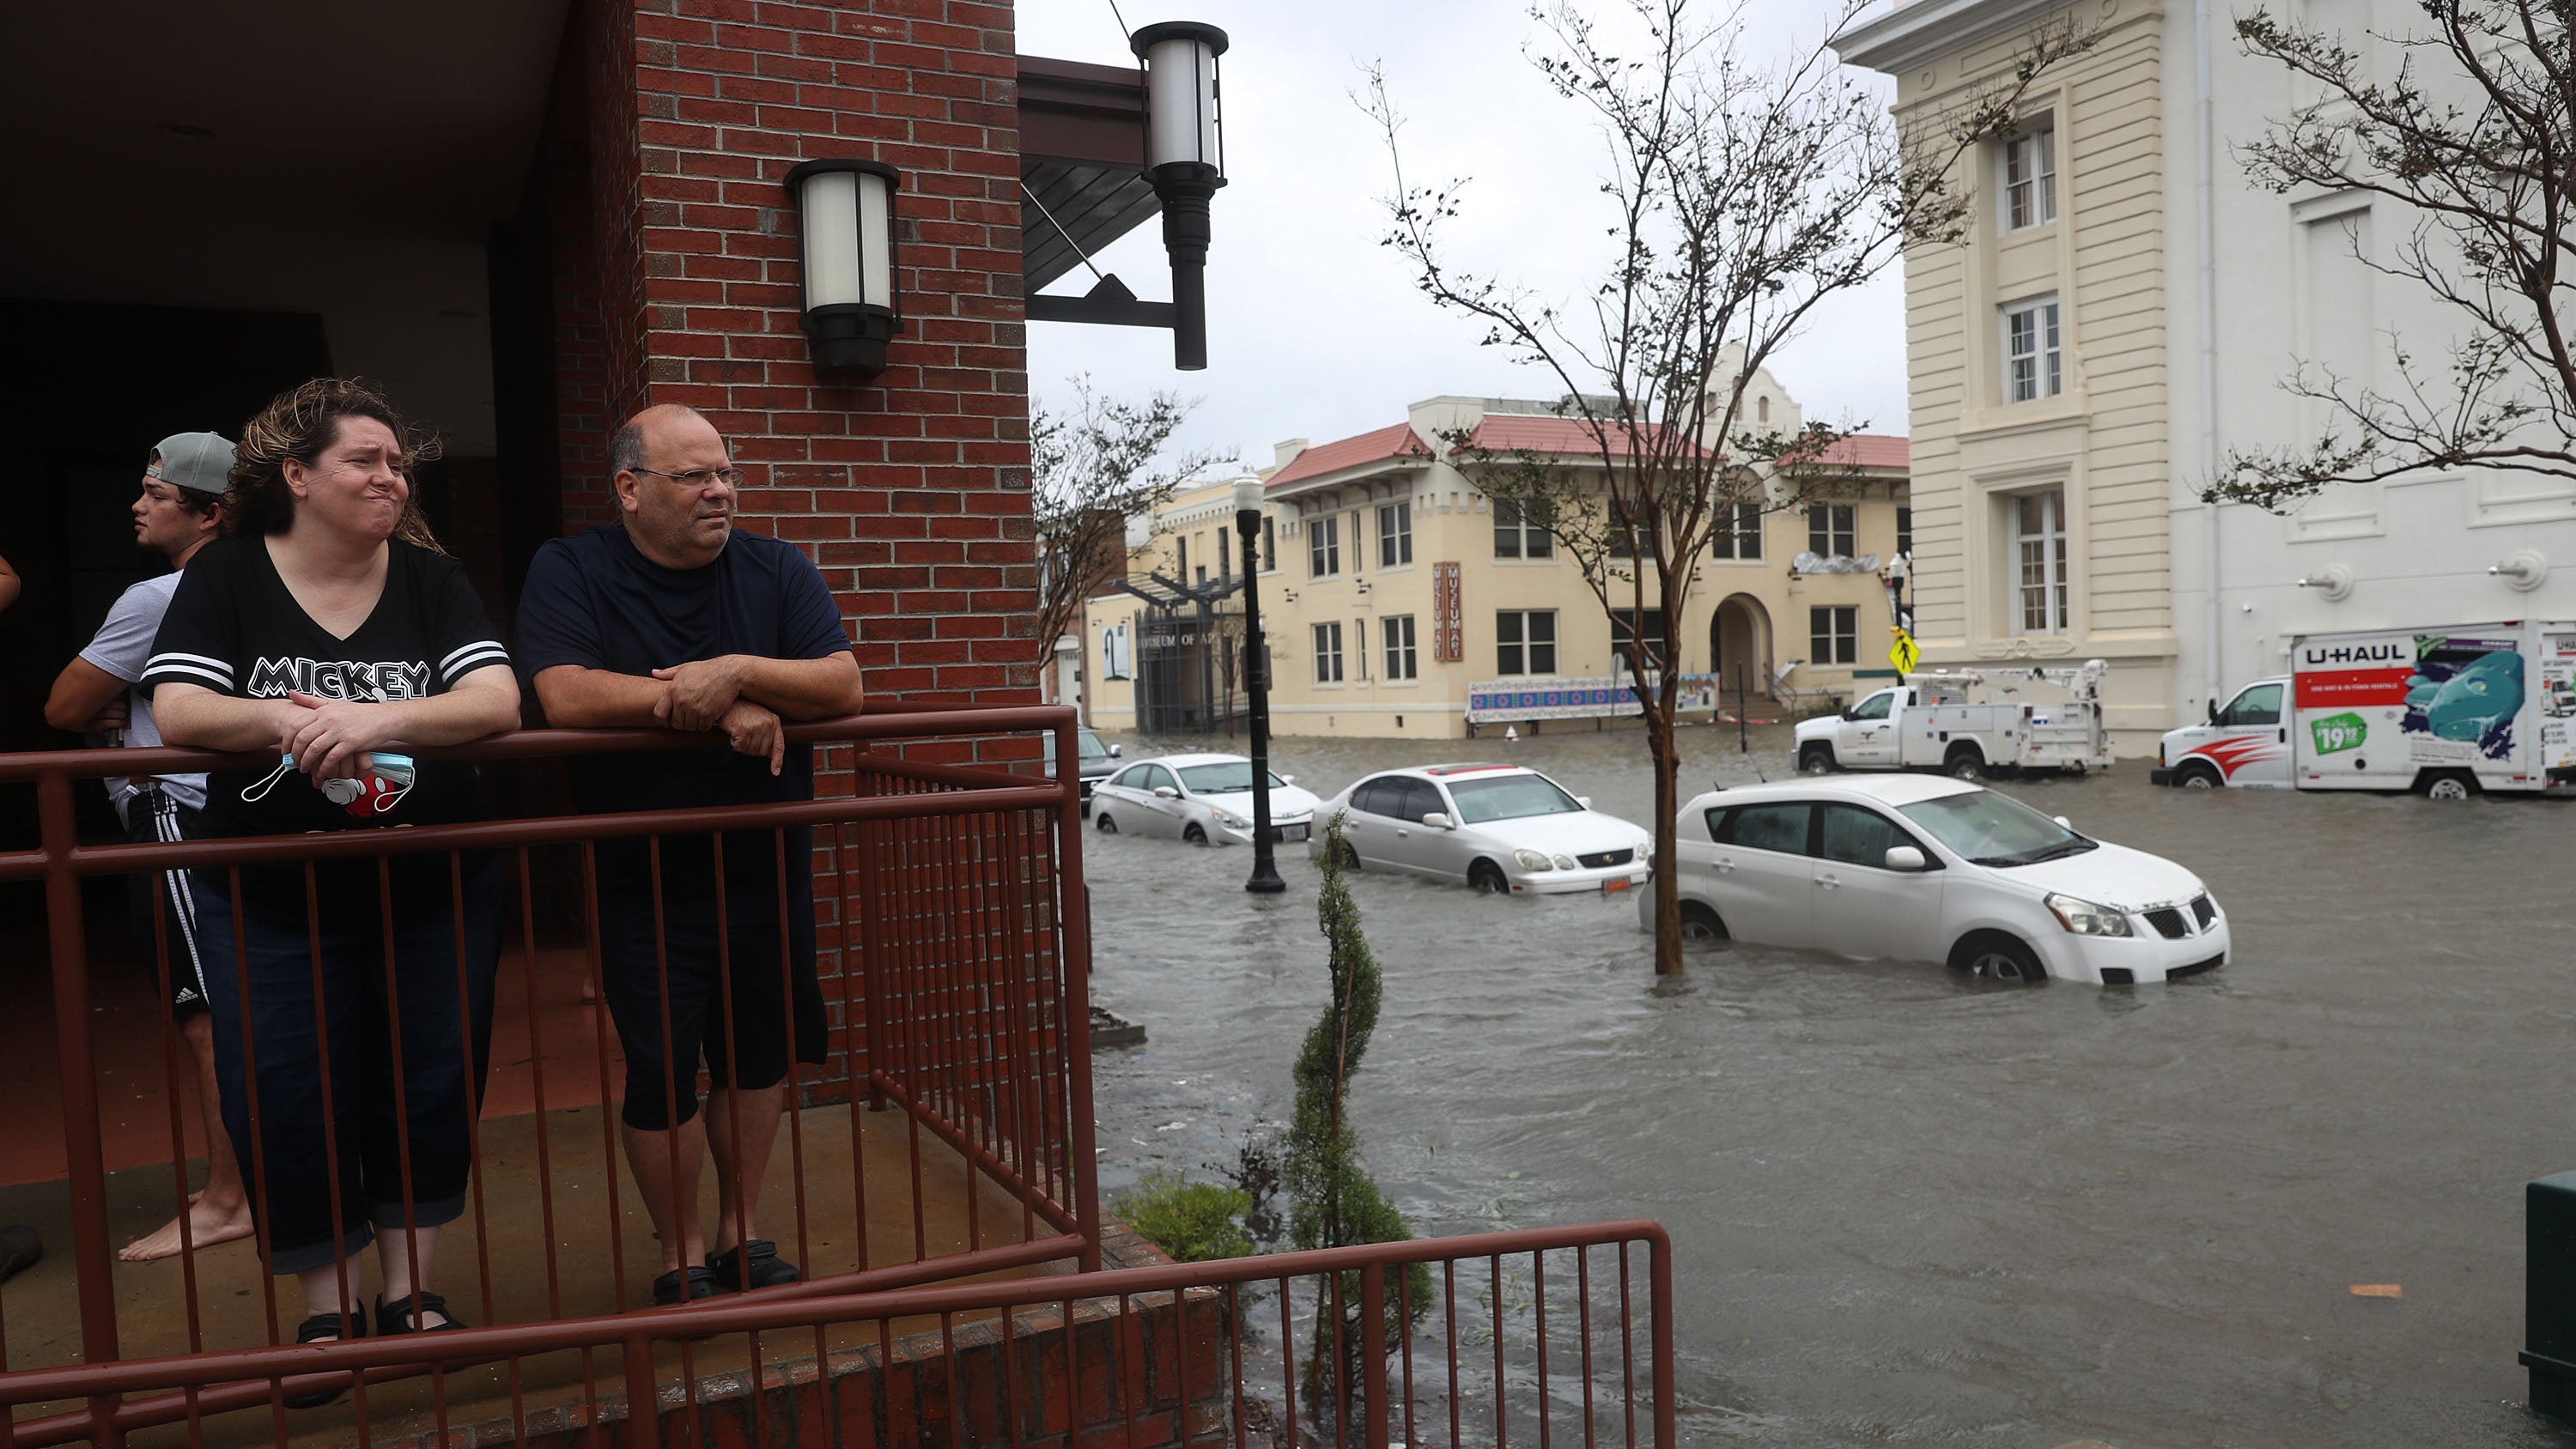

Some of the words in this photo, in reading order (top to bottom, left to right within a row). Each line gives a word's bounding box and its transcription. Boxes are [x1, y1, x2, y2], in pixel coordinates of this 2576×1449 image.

[1448, 567, 1460, 630] MUSEUM
[1181, 634, 1195, 646] OF
[2306, 645, 2406, 664] U-HAUL
[248, 657, 431, 701] MICKEY
[175, 993, 199, 1004] adidas
